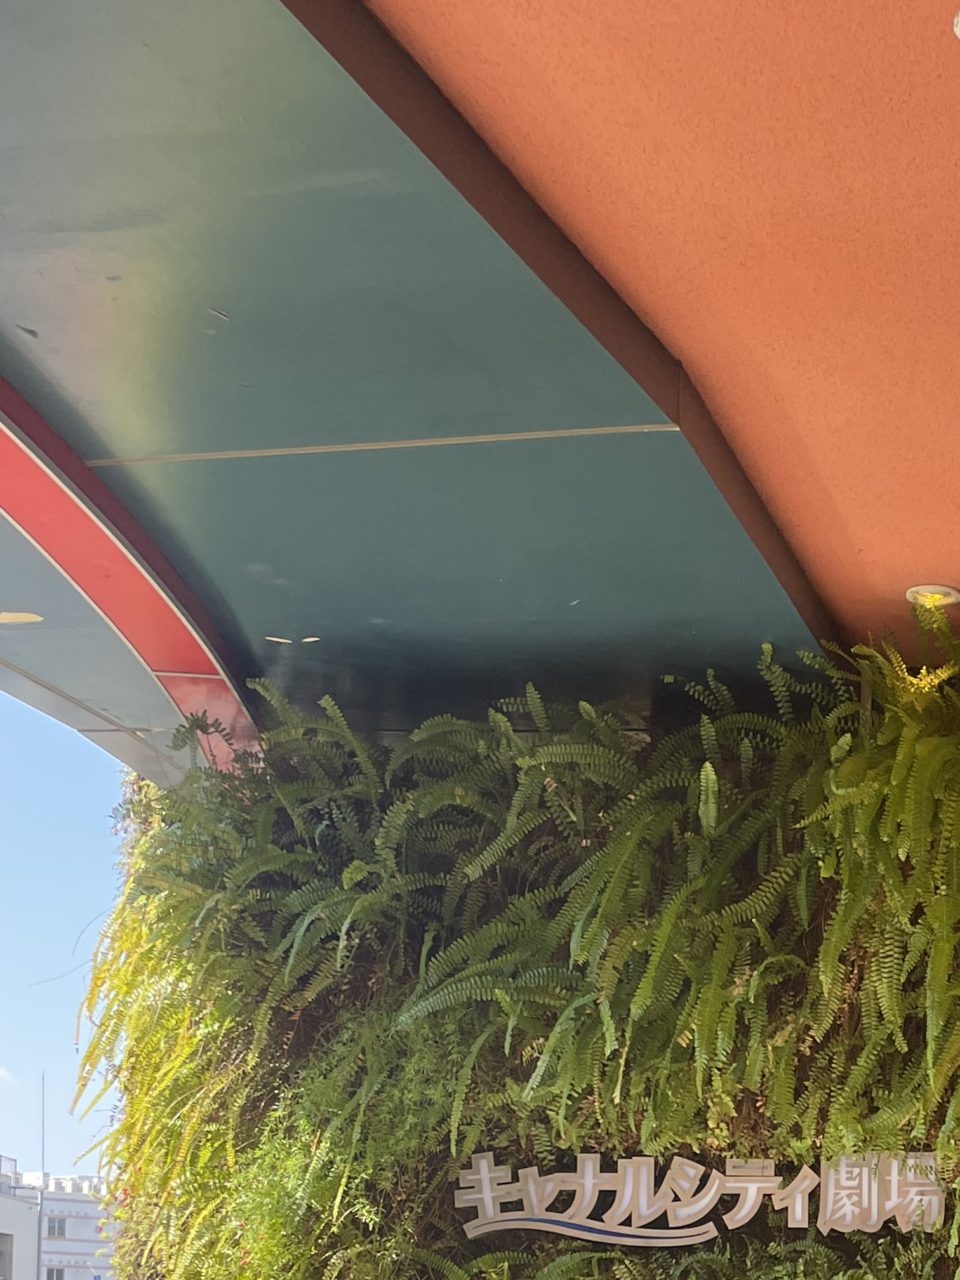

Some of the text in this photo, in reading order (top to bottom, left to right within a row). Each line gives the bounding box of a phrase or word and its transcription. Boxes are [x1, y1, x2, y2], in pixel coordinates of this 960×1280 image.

[455, 1151, 946, 1236] キャナルシティ劇場
